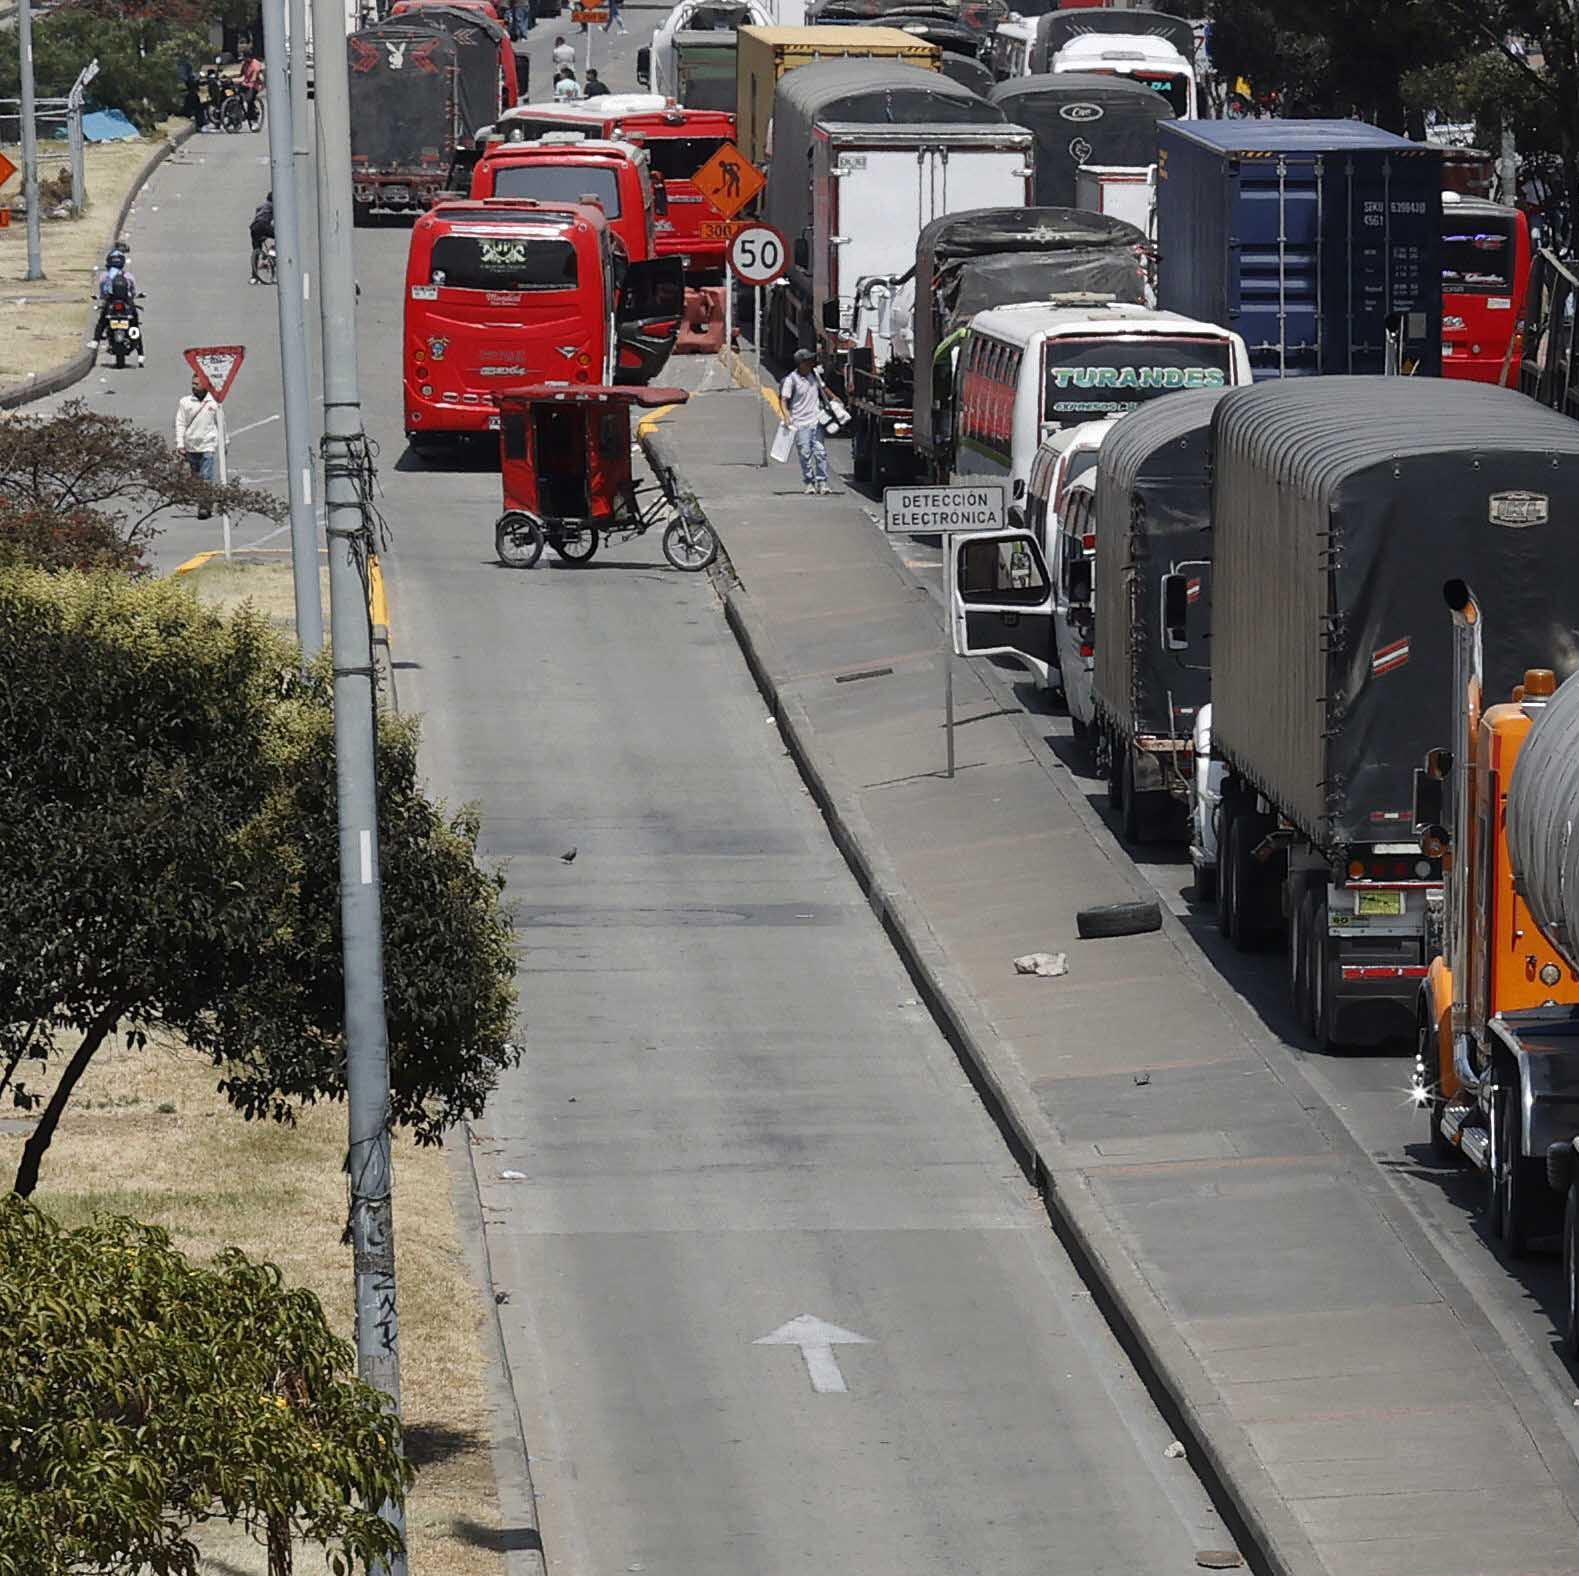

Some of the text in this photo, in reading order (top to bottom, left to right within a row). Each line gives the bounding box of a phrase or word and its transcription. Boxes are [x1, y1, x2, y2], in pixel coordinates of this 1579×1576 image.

[705, 225, 732, 237] 300
[740, 240, 778, 269] 50
[1051, 367, 1225, 388] TURANDES
[902, 490, 988, 508] DETECCIÓN
[892, 510, 998, 526] ELECTRÓNICA
